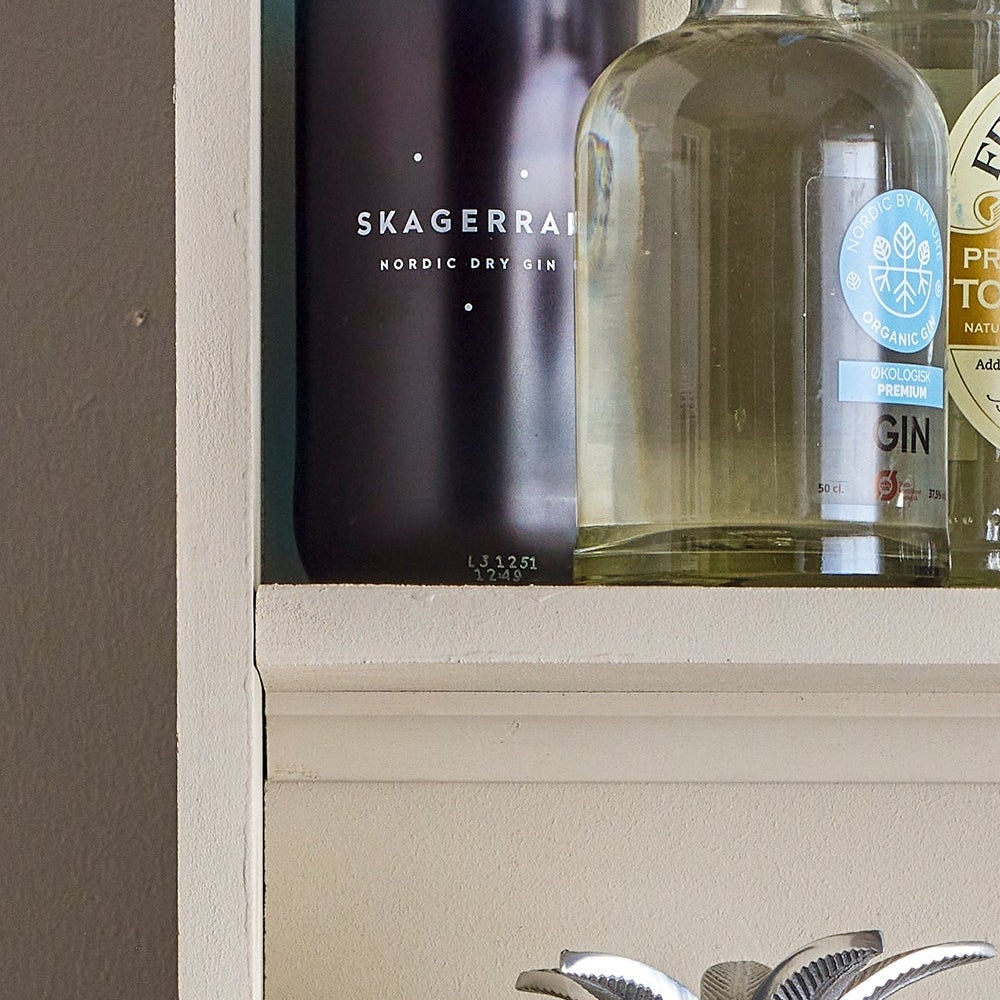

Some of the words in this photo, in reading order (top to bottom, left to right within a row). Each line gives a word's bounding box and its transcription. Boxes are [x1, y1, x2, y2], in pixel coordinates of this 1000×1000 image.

[847, 197, 893, 254] NORDIC
[896, 193, 914, 208] BY
[915, 199, 943, 262] NATURE
[380, 257, 457, 271] NORDIC
[470, 257, 510, 270] DRY
[523, 258, 556, 272] GIN
[862, 311, 919, 346] ORGANIC
[920, 315, 937, 341] GIN
[975, 358, 1000, 371] Add
[870, 366, 932, 383] ØKOLOGISK
[877, 383, 928, 399] PREMIUM
[873, 414, 930, 455] GIN
[818, 483, 831, 494] 50
[833, 483, 845, 495] cl.
